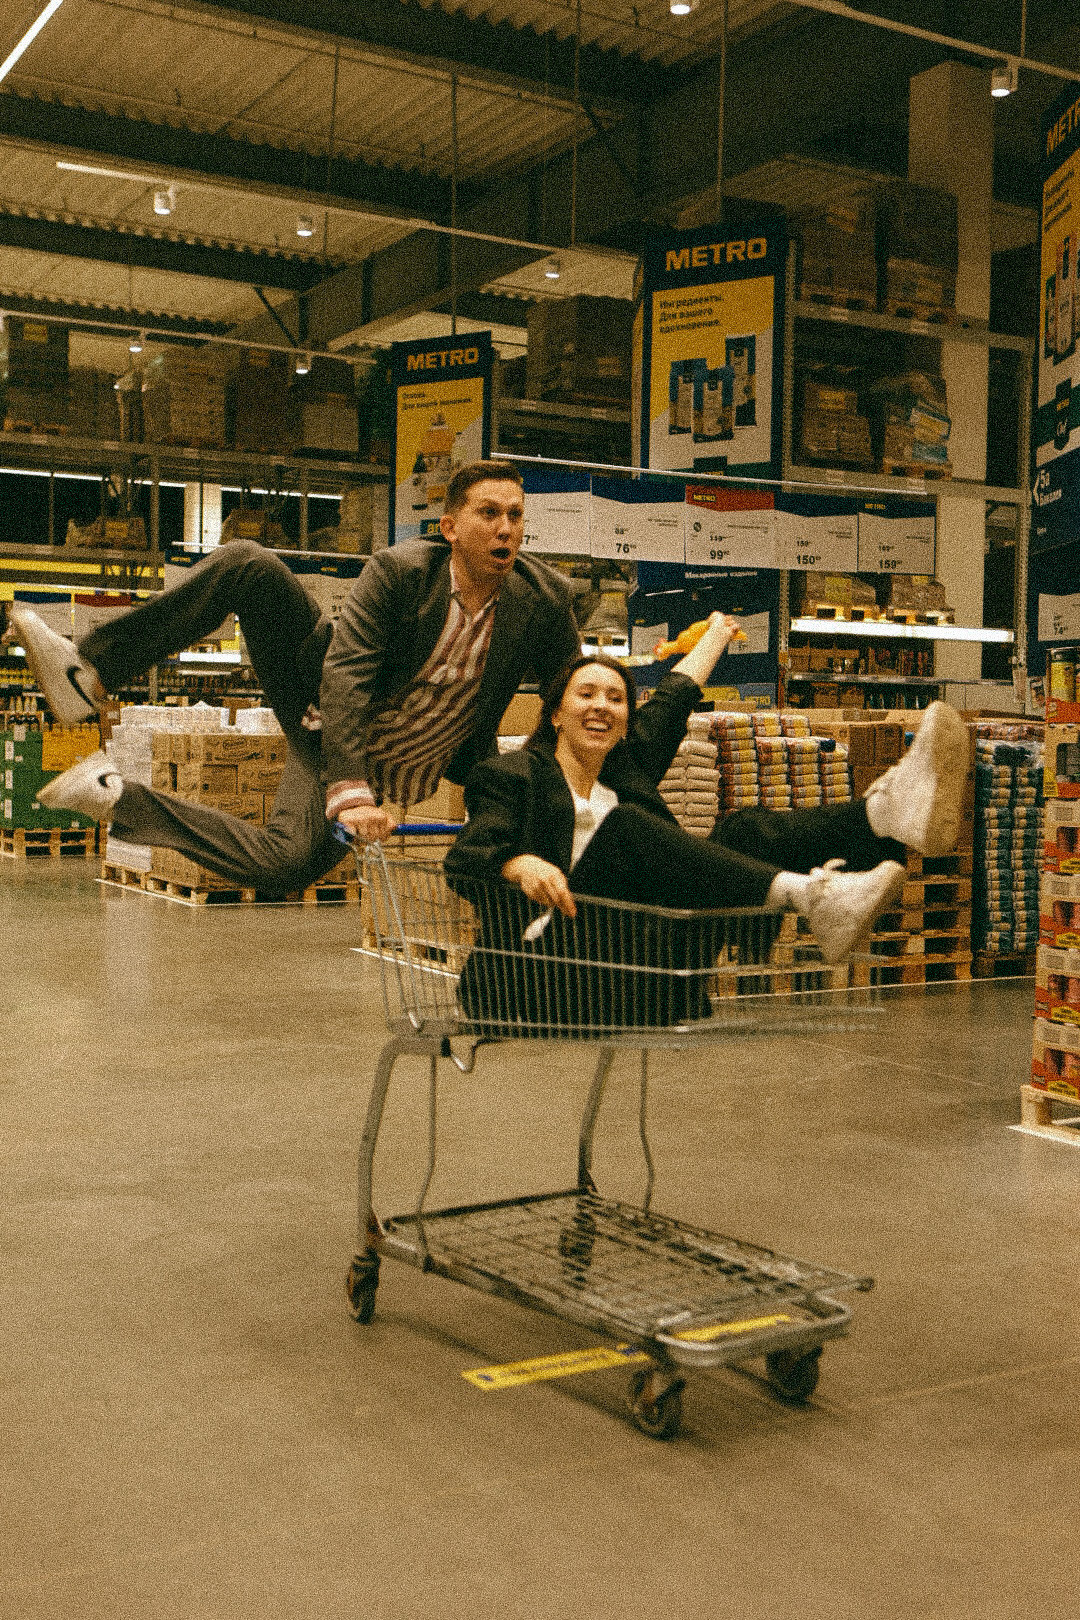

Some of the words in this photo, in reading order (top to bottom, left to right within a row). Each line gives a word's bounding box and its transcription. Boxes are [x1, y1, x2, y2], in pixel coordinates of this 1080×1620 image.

[1046, 98, 1080, 157] METR
[665, 238, 767, 271] METRO
[407, 347, 478, 372] METRO
[427, 522, 440, 535] ar
